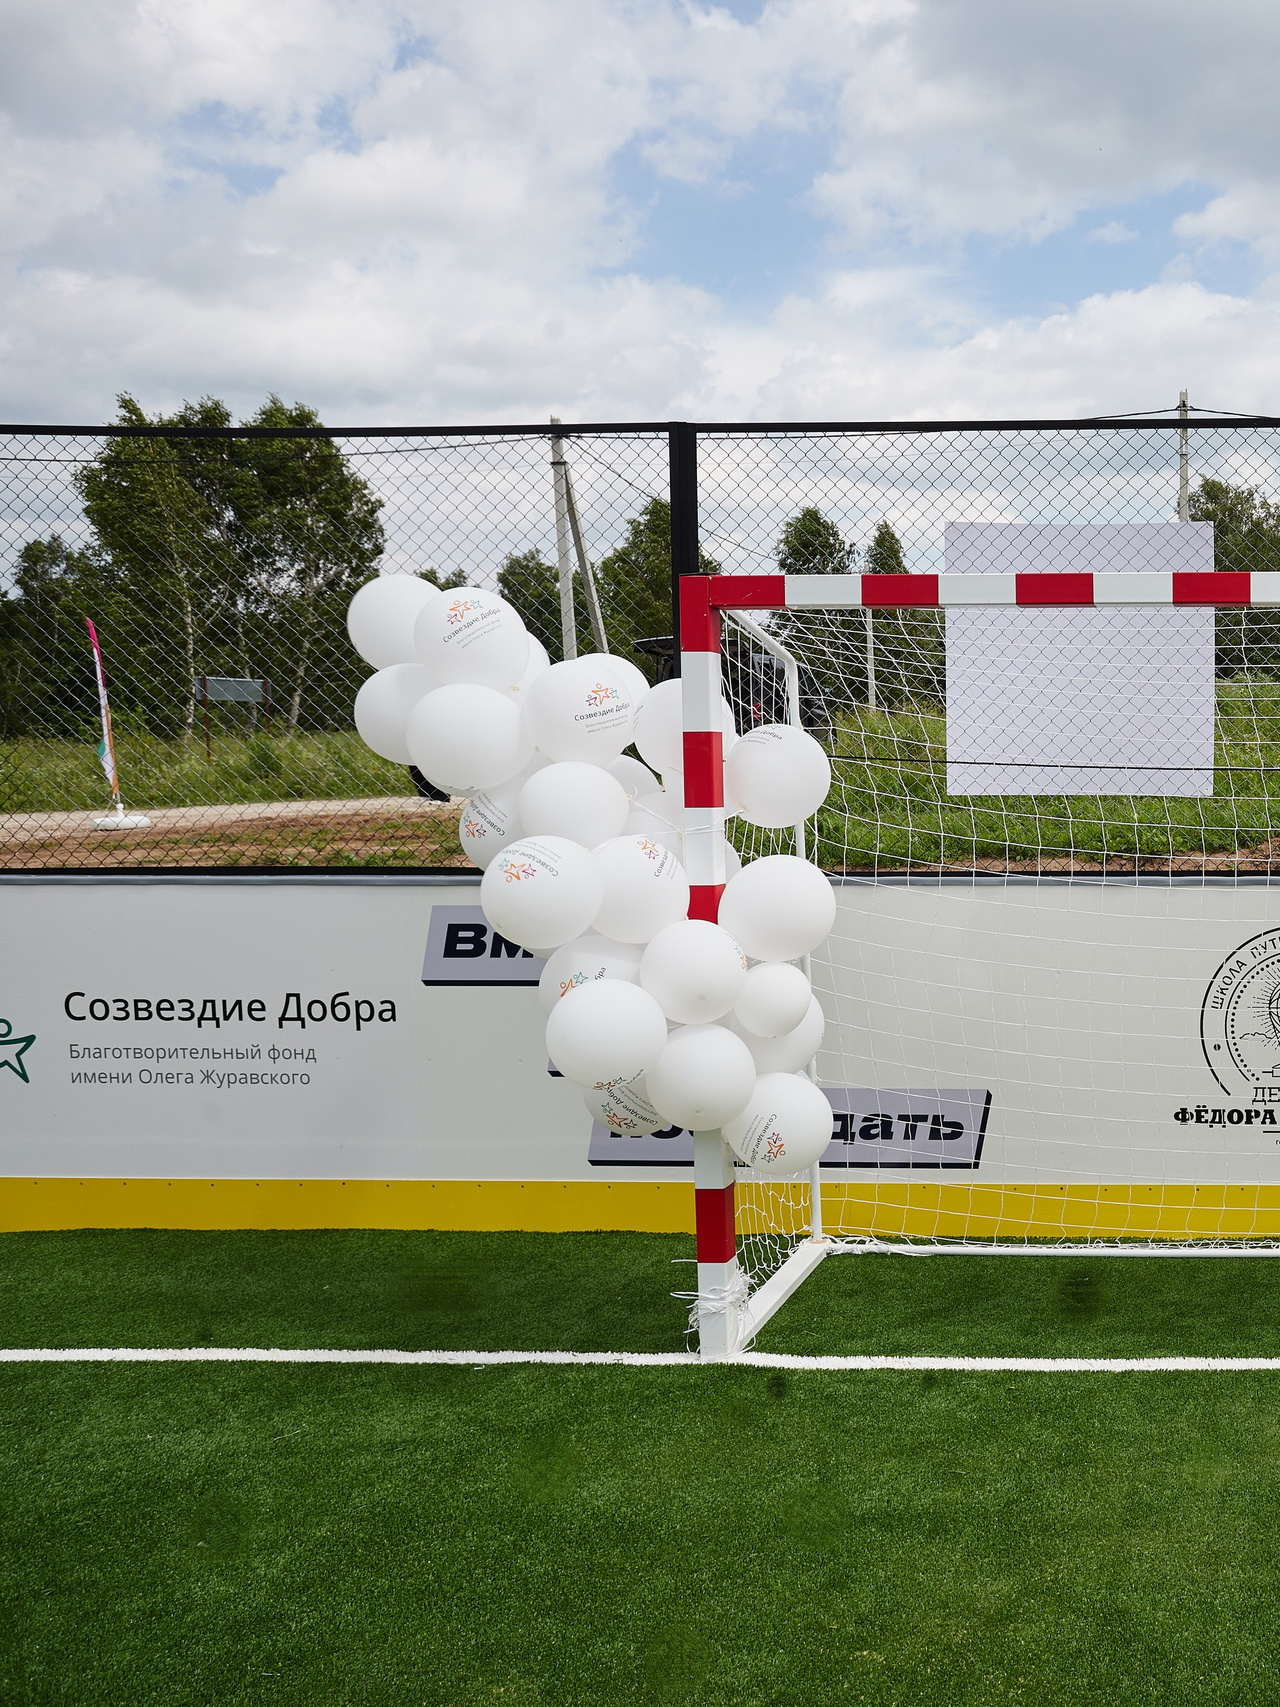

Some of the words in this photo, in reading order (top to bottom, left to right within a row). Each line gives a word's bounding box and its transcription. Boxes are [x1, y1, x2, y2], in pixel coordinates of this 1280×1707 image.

[443, 617, 480, 643] Созвездие
[574, 708, 614, 721] Созвездие
[477, 809, 506, 837] Созвездие
[1211, 958, 1248, 1010] ШКОЛА
[64, 991, 267, 1029] Созвездие
[278, 991, 397, 1031] Добра
[69, 1044, 262, 1064] Благотворительный
[267, 1043, 317, 1065] фонд
[71, 1071, 133, 1085] имени
[138, 1069, 195, 1085] Олега
[199, 1069, 311, 1089] Журавского
[622, 1104, 658, 1126] Созвездие
[1173, 1104, 1277, 1128] ФЁДОРА
[755, 1113, 778, 1149] Созвездие
